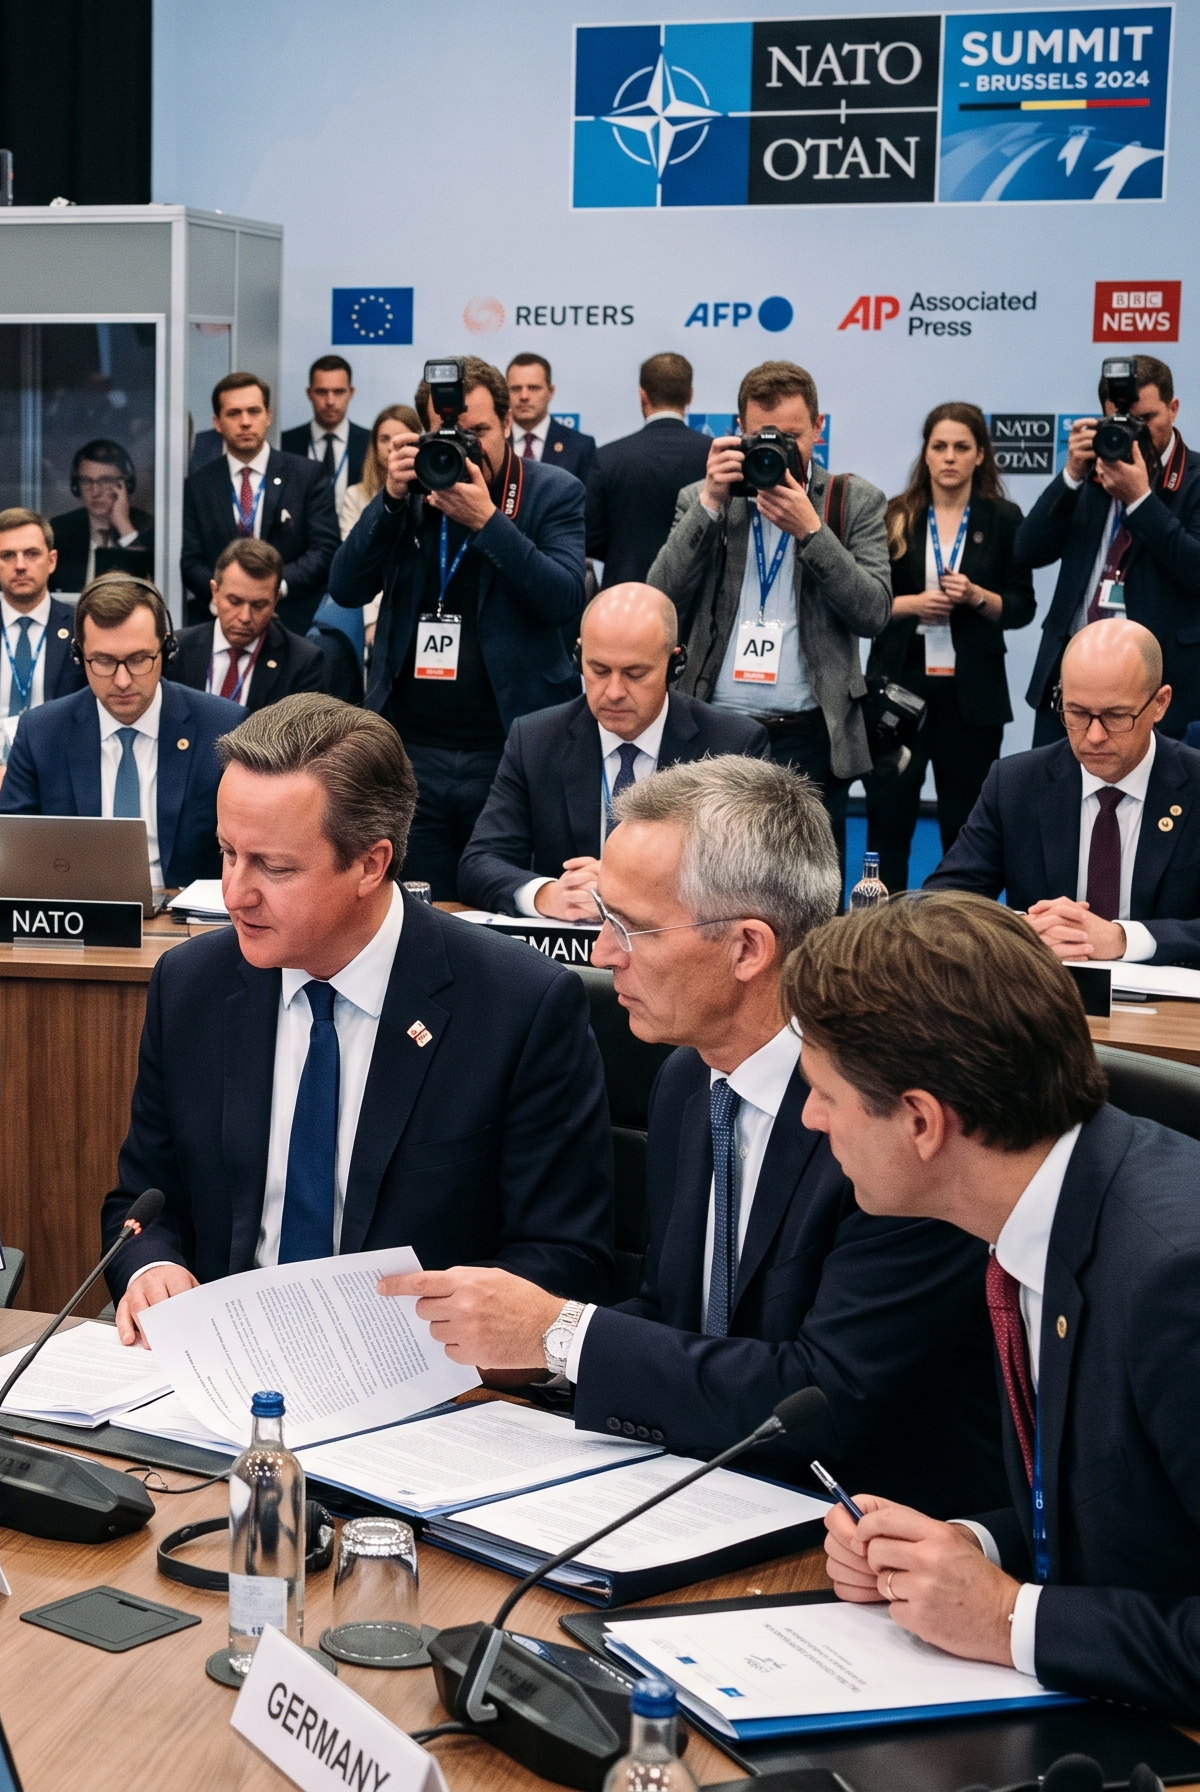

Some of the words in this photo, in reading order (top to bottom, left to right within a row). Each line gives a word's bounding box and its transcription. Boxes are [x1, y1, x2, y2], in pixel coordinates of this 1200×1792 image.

[961, 26, 1153, 67] SUMMIT
[766, 42, 922, 88] NATO
[976, 72, 1088, 92] BRUSSELS
[1094, 70, 1150, 89] 2024
[763, 136, 920, 181] OTAN
[909, 291, 1037, 311] Associated
[1112, 291, 1163, 308] BBC
[516, 305, 634, 326] REUTERS
[684, 302, 753, 328] AFP
[838, 296, 900, 331] AP
[1102, 312, 1171, 332] NEWS
[908, 316, 972, 336] Press
[996, 419, 1050, 437] NATO
[994, 452, 1048, 468] OTAN
[423, 634, 454, 653] AP
[743, 638, 775, 657] AP
[13, 910, 84, 935] NATO
[267, 1682, 391, 1792] GERMANY
